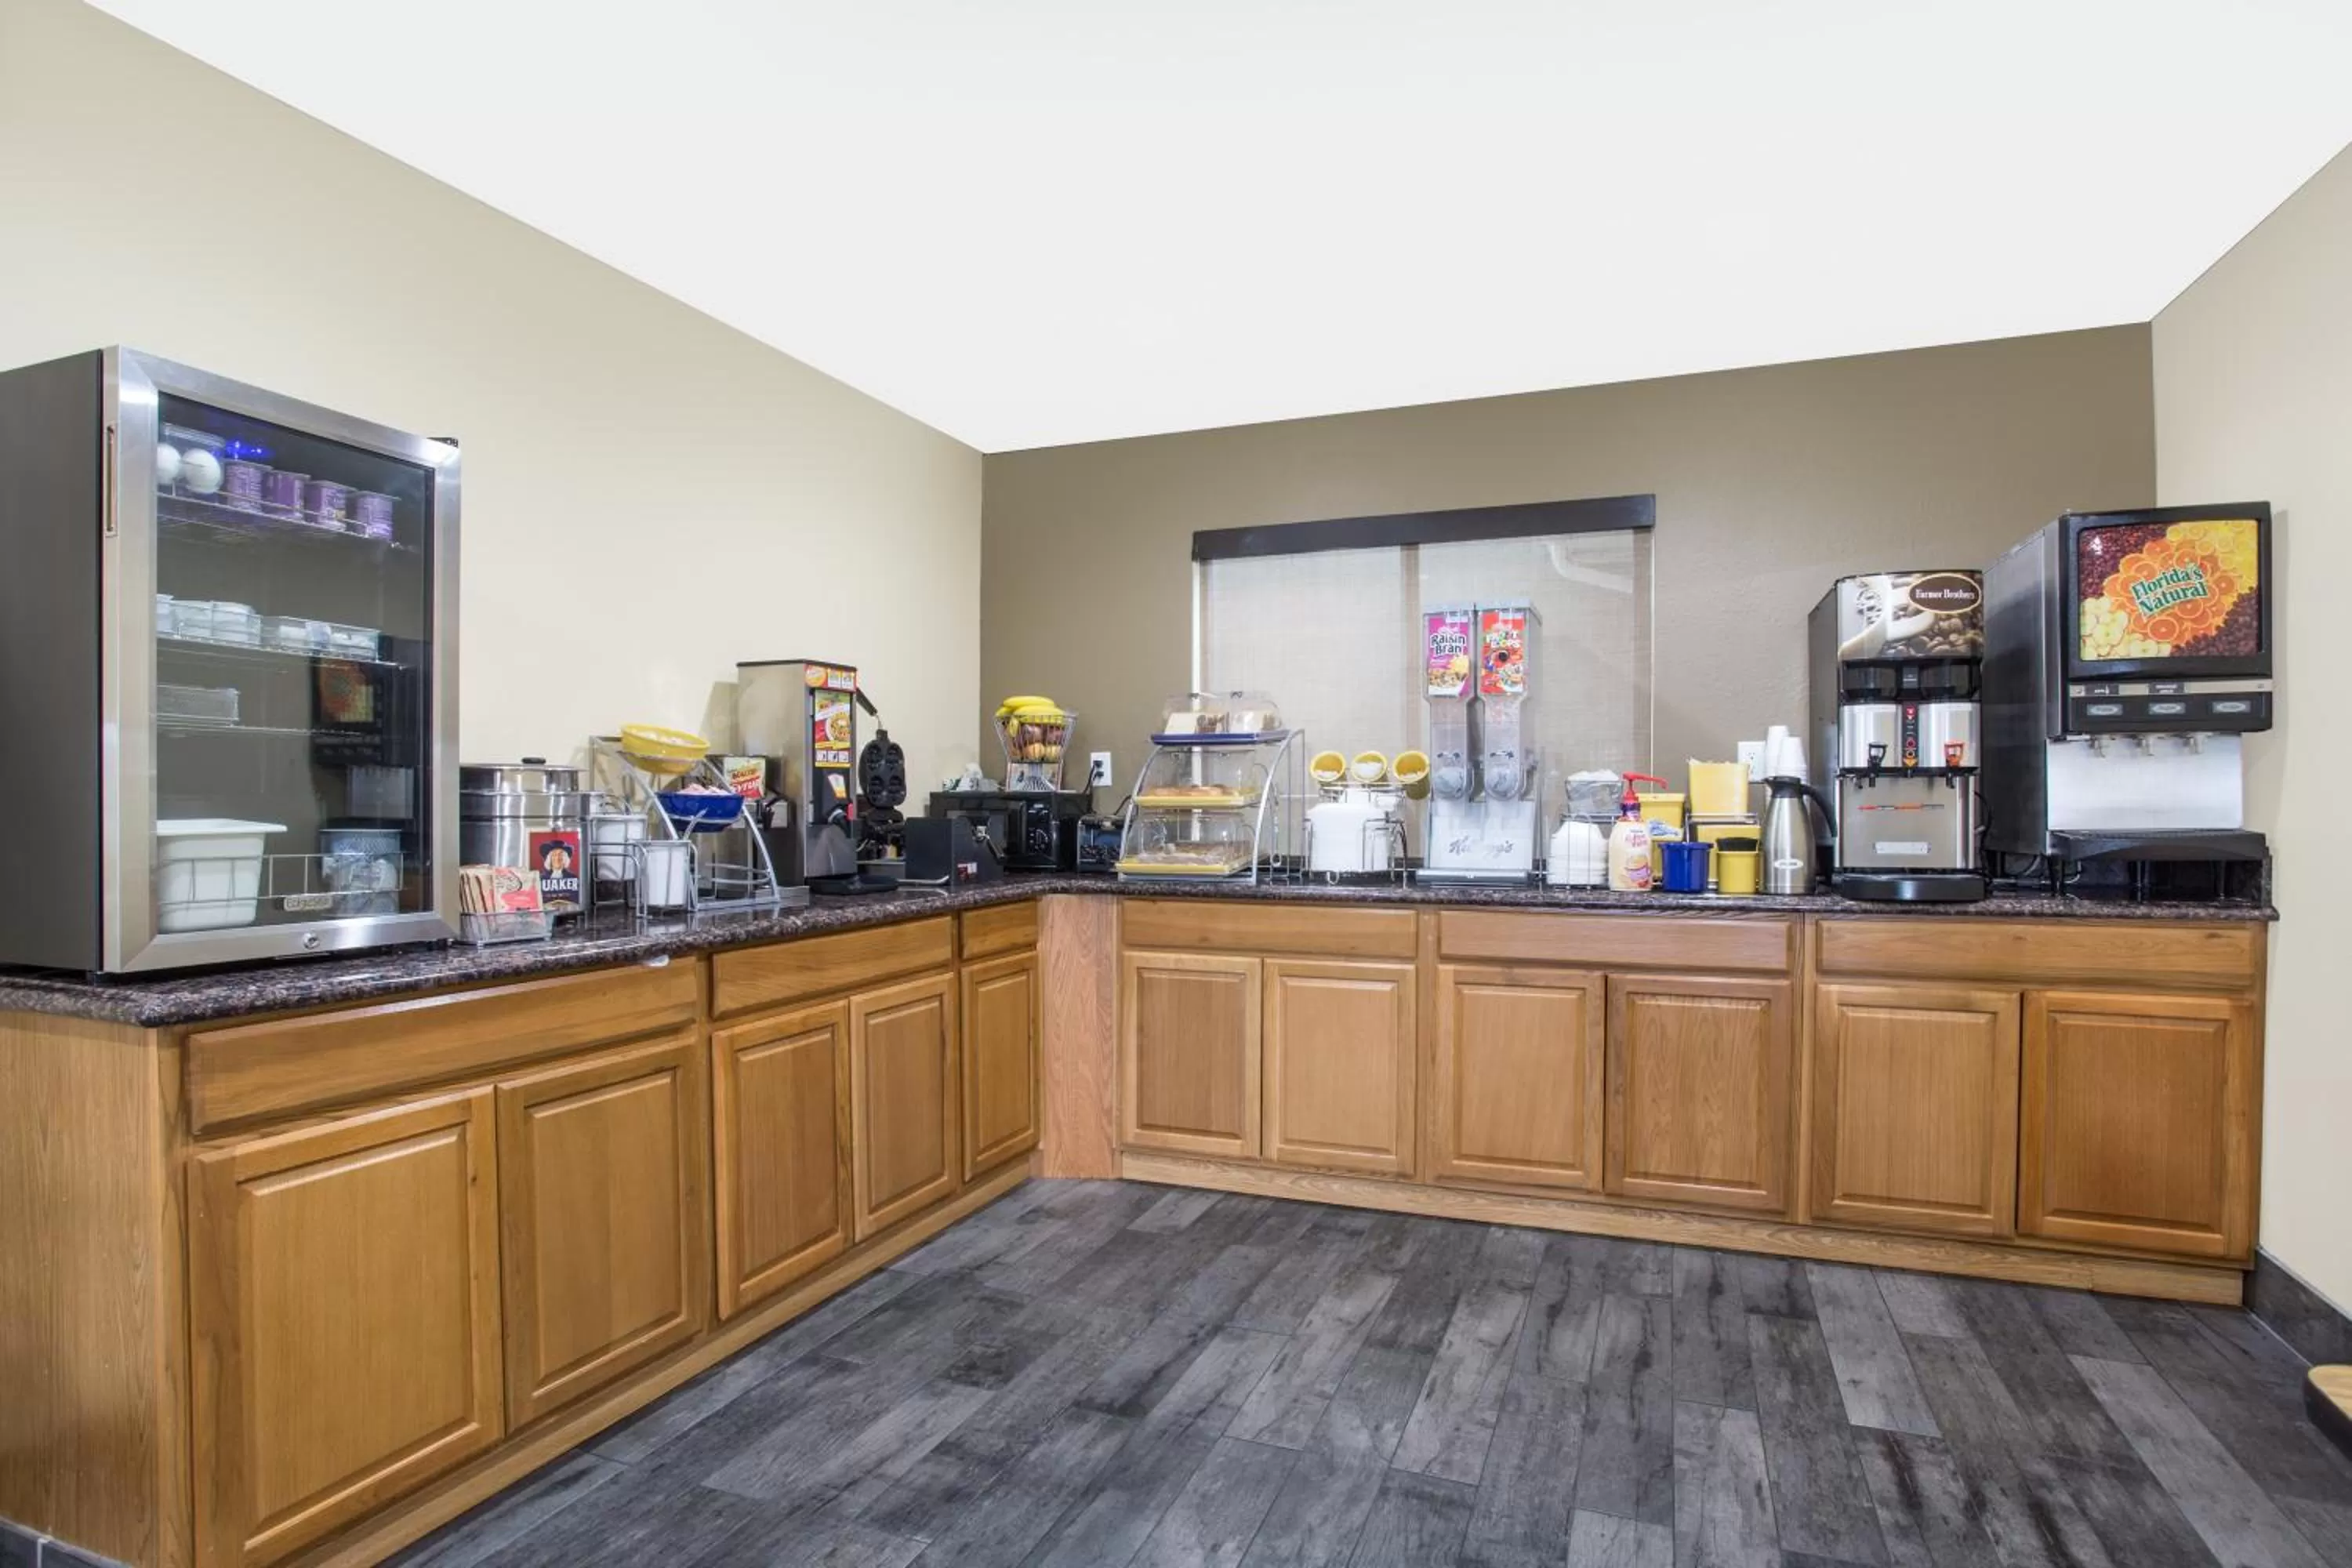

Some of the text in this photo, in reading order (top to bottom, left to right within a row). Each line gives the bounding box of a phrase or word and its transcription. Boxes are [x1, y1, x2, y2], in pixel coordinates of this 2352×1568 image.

[2132, 568, 2204, 601] Florida's
[1915, 589, 1942, 599] Farmer
[2138, 580, 2209, 613] Natural
[1431, 633, 1465, 644] Raisin
[1436, 643, 1461, 655] Bran
[541, 878, 579, 891] UAKER
